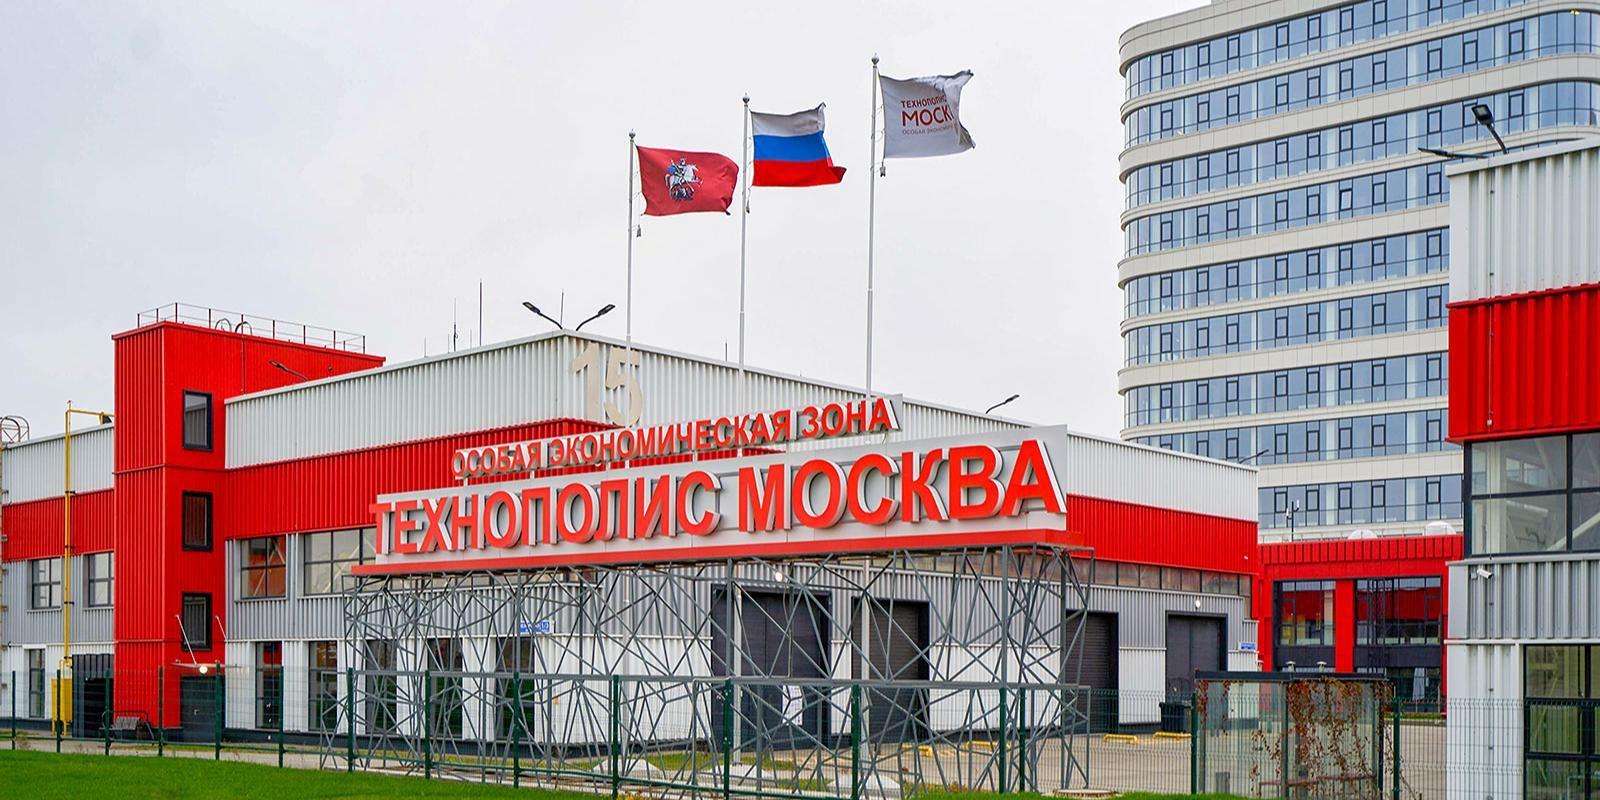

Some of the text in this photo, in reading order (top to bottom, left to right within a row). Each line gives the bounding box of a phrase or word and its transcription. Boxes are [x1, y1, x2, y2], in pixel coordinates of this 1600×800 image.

[570, 341, 643, 427] 15
[451, 397, 899, 477] ОСОБАЯ ЭКОНОМИЧЕСКАЯ ЗОНА
[369, 439, 1068, 556] ТЕХНОПОЛИС МОСКВА
